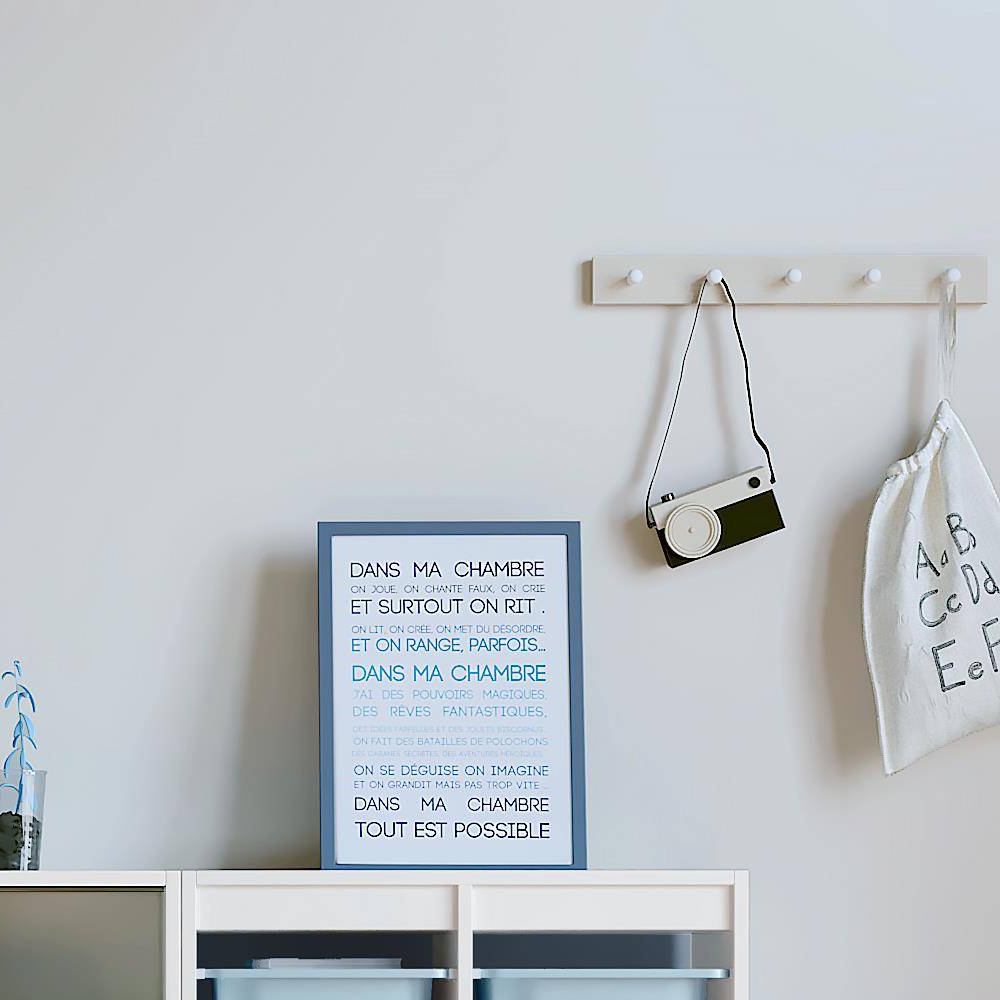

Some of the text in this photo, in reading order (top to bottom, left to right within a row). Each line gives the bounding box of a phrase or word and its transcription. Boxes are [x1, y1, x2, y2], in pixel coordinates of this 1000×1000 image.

[350, 562, 544, 578] DANS MA CHAMBRE
[350, 584, 366, 594] ON
[404, 584, 418, 594] ON
[425, 584, 463, 594] CHANTE
[501, 584, 516, 594] ON
[522, 584, 546, 594] CRIE
[351, 599, 535, 614] ET SURTOUT ON RIT
[352, 625, 368, 634] ON
[390, 625, 404, 634] ON
[436, 625, 450, 634] ON
[454, 625, 473, 634] MET
[476, 625, 490, 634] DU
[352, 638, 370, 652] ET
[376, 638, 400, 652] ON
[406, 638, 464, 652] RANGE,
[352, 665, 546, 682] DANS MA CHAMBRE
[382, 690, 404, 700] DES
[413, 690, 474, 700] POUVOIRS
[352, 706, 378, 717] DES
[353, 737, 368, 746] ON
[418, 737, 468, 746] BATAILLES
[354, 764, 549, 776] ON SE DÉGUISE ON IMAGINE
[354, 780, 365, 789] ET
[369, 780, 384, 789] ON
[388, 780, 432, 789] GRANDIT
[435, 780, 460, 789] MAIS
[464, 780, 482, 789] PAS
[488, 780, 512, 789] TROP
[354, 797, 549, 812] DANS MA CHAMBRE
[355, 822, 550, 838] TOUT EST POSSIBLE
